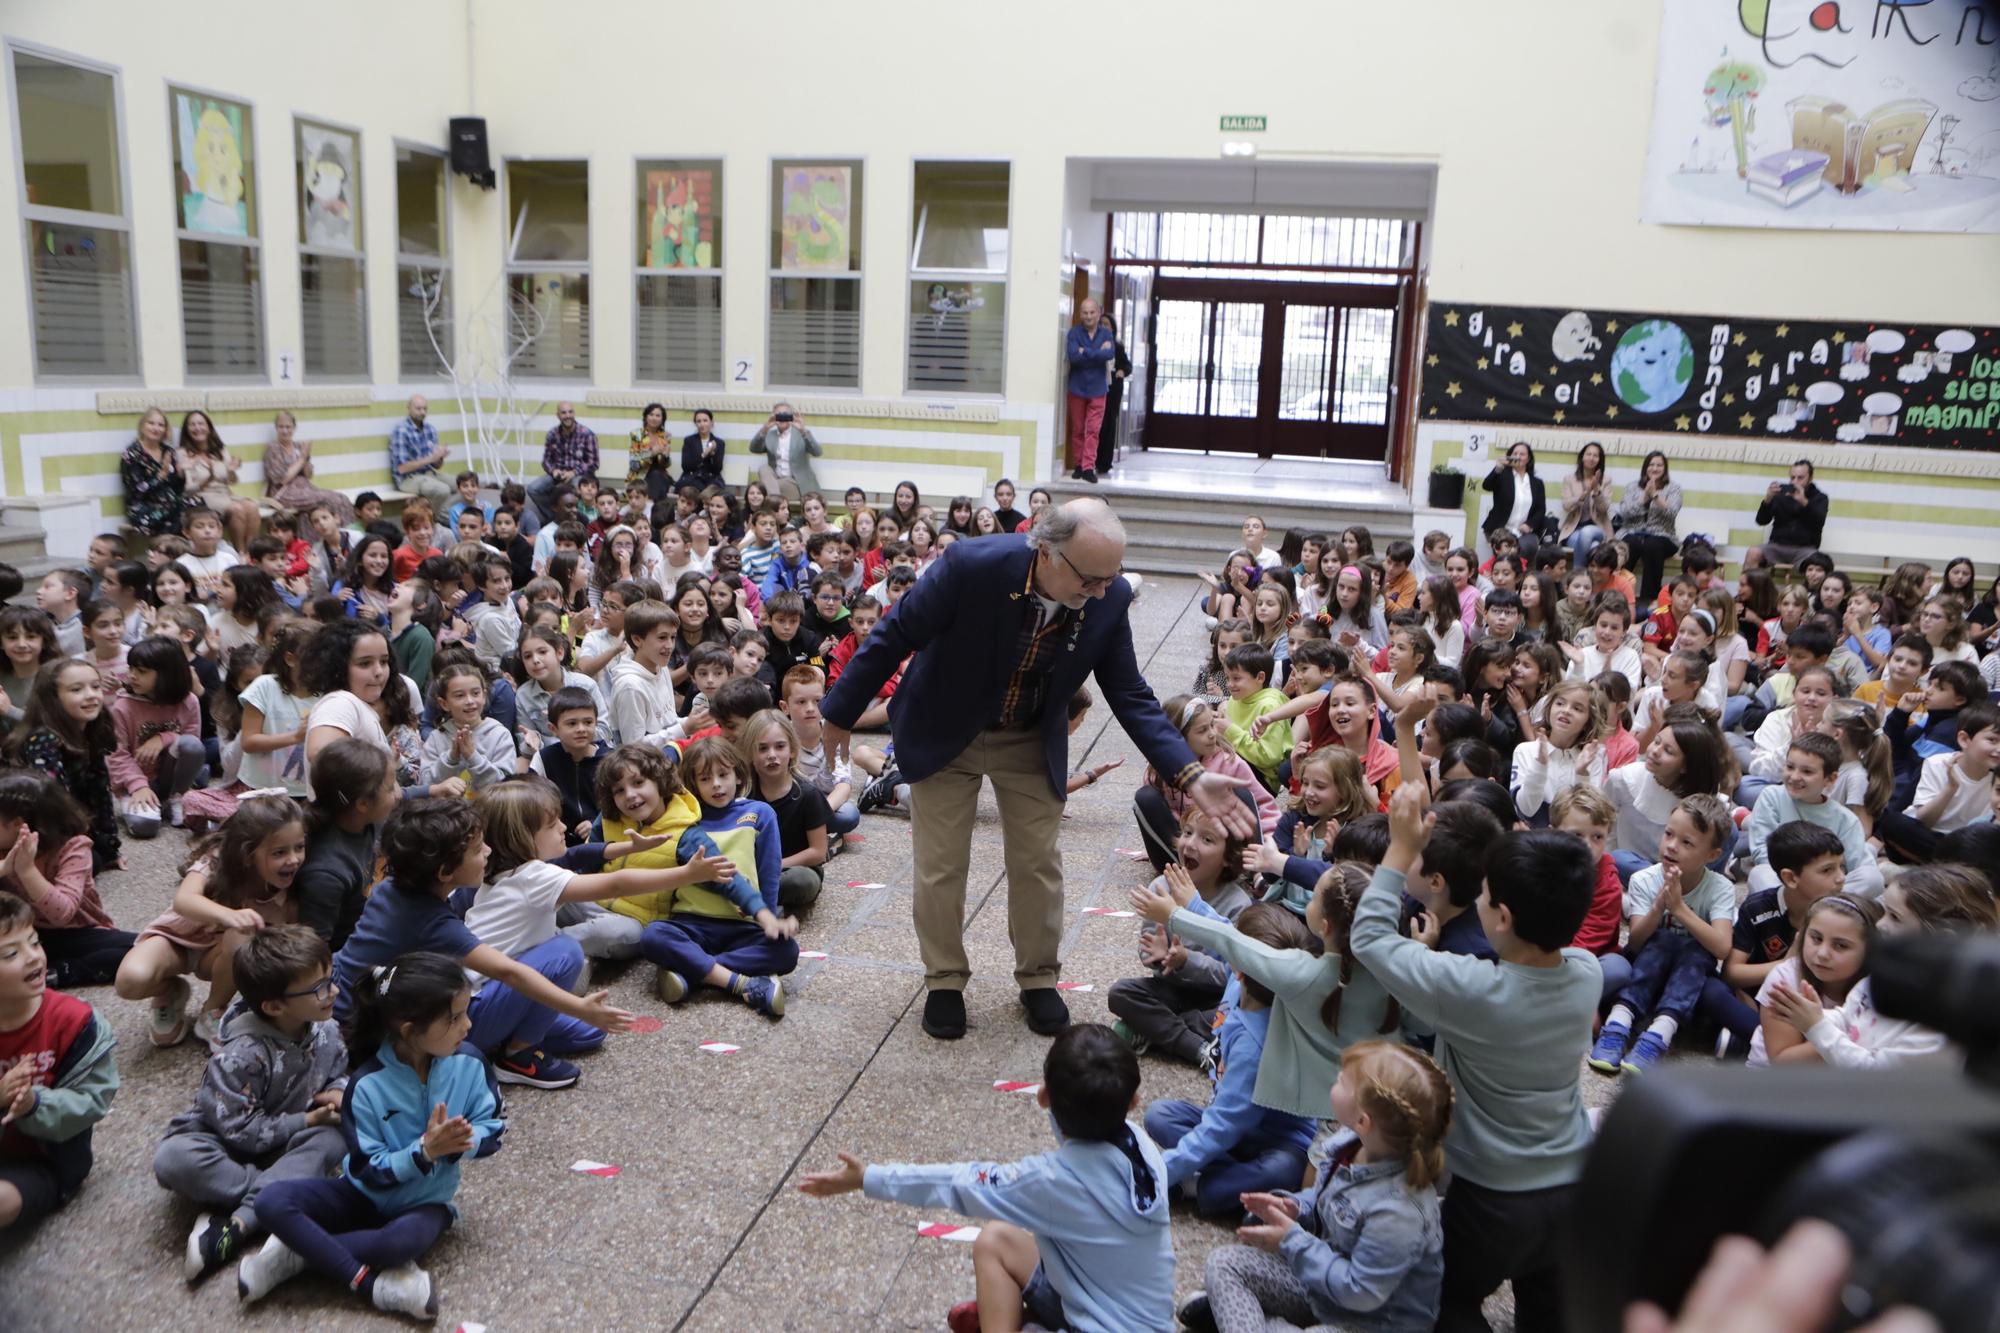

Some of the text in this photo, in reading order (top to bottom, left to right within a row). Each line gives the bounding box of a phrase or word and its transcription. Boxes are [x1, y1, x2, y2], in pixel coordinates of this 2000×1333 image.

[1223, 118, 1264, 128] SALIDA
[1468, 311, 1527, 377] gira
[1745, 339, 1829, 401] gira
[1554, 381, 1581, 405] el
[1696, 324, 1731, 432] mundo
